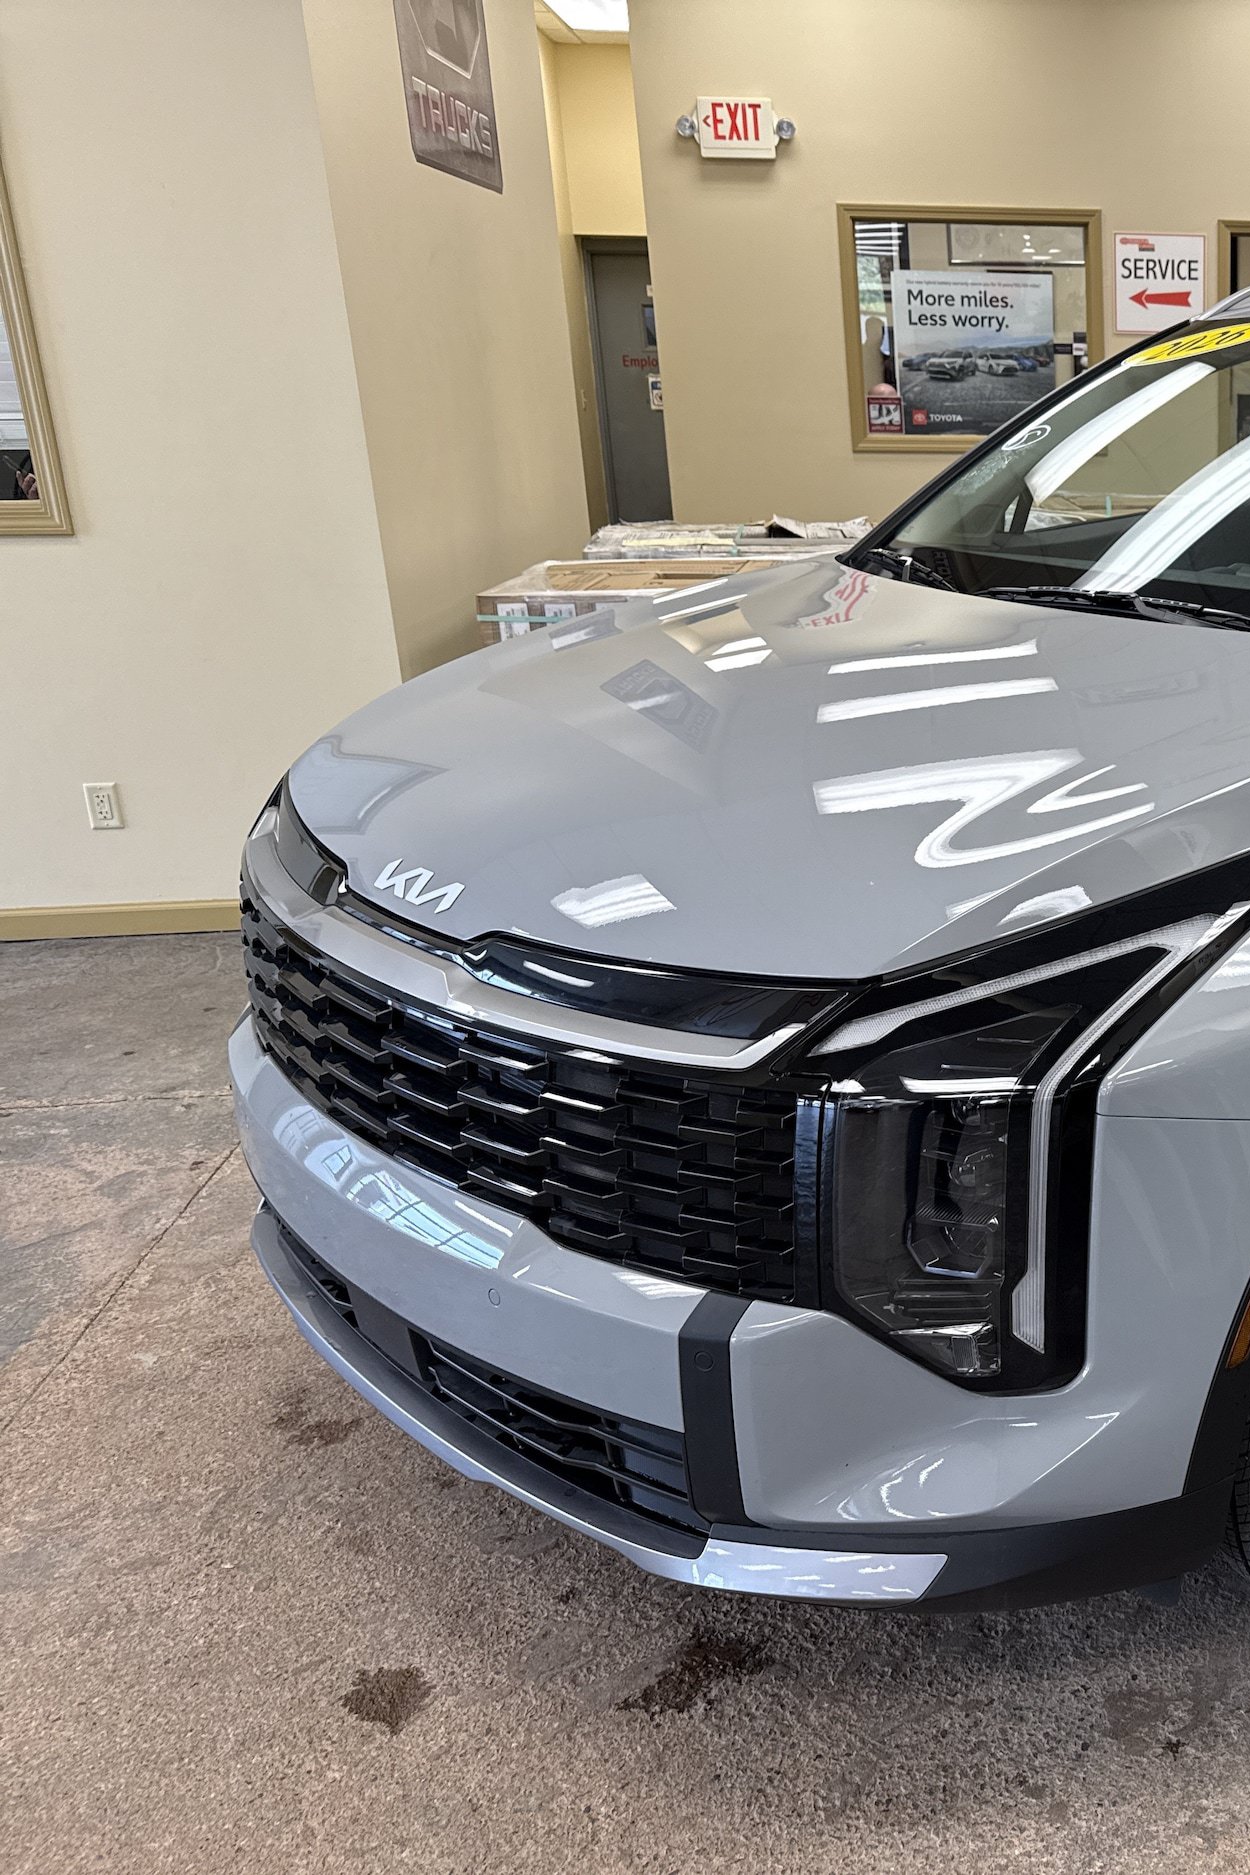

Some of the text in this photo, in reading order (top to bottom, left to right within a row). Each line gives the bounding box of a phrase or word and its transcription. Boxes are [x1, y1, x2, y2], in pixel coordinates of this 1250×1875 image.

[411, 75, 494, 159] TRUCKS
[711, 103, 761, 141] EXIT
[1121, 258, 1199, 281] SERVICE
[907, 289, 1014, 309] More miles.
[908, 309, 1009, 332] Less worry.
[622, 354, 659, 371] Emplo
[929, 414, 963, 422] TOYOTA
[374, 859, 465, 914] KIA
